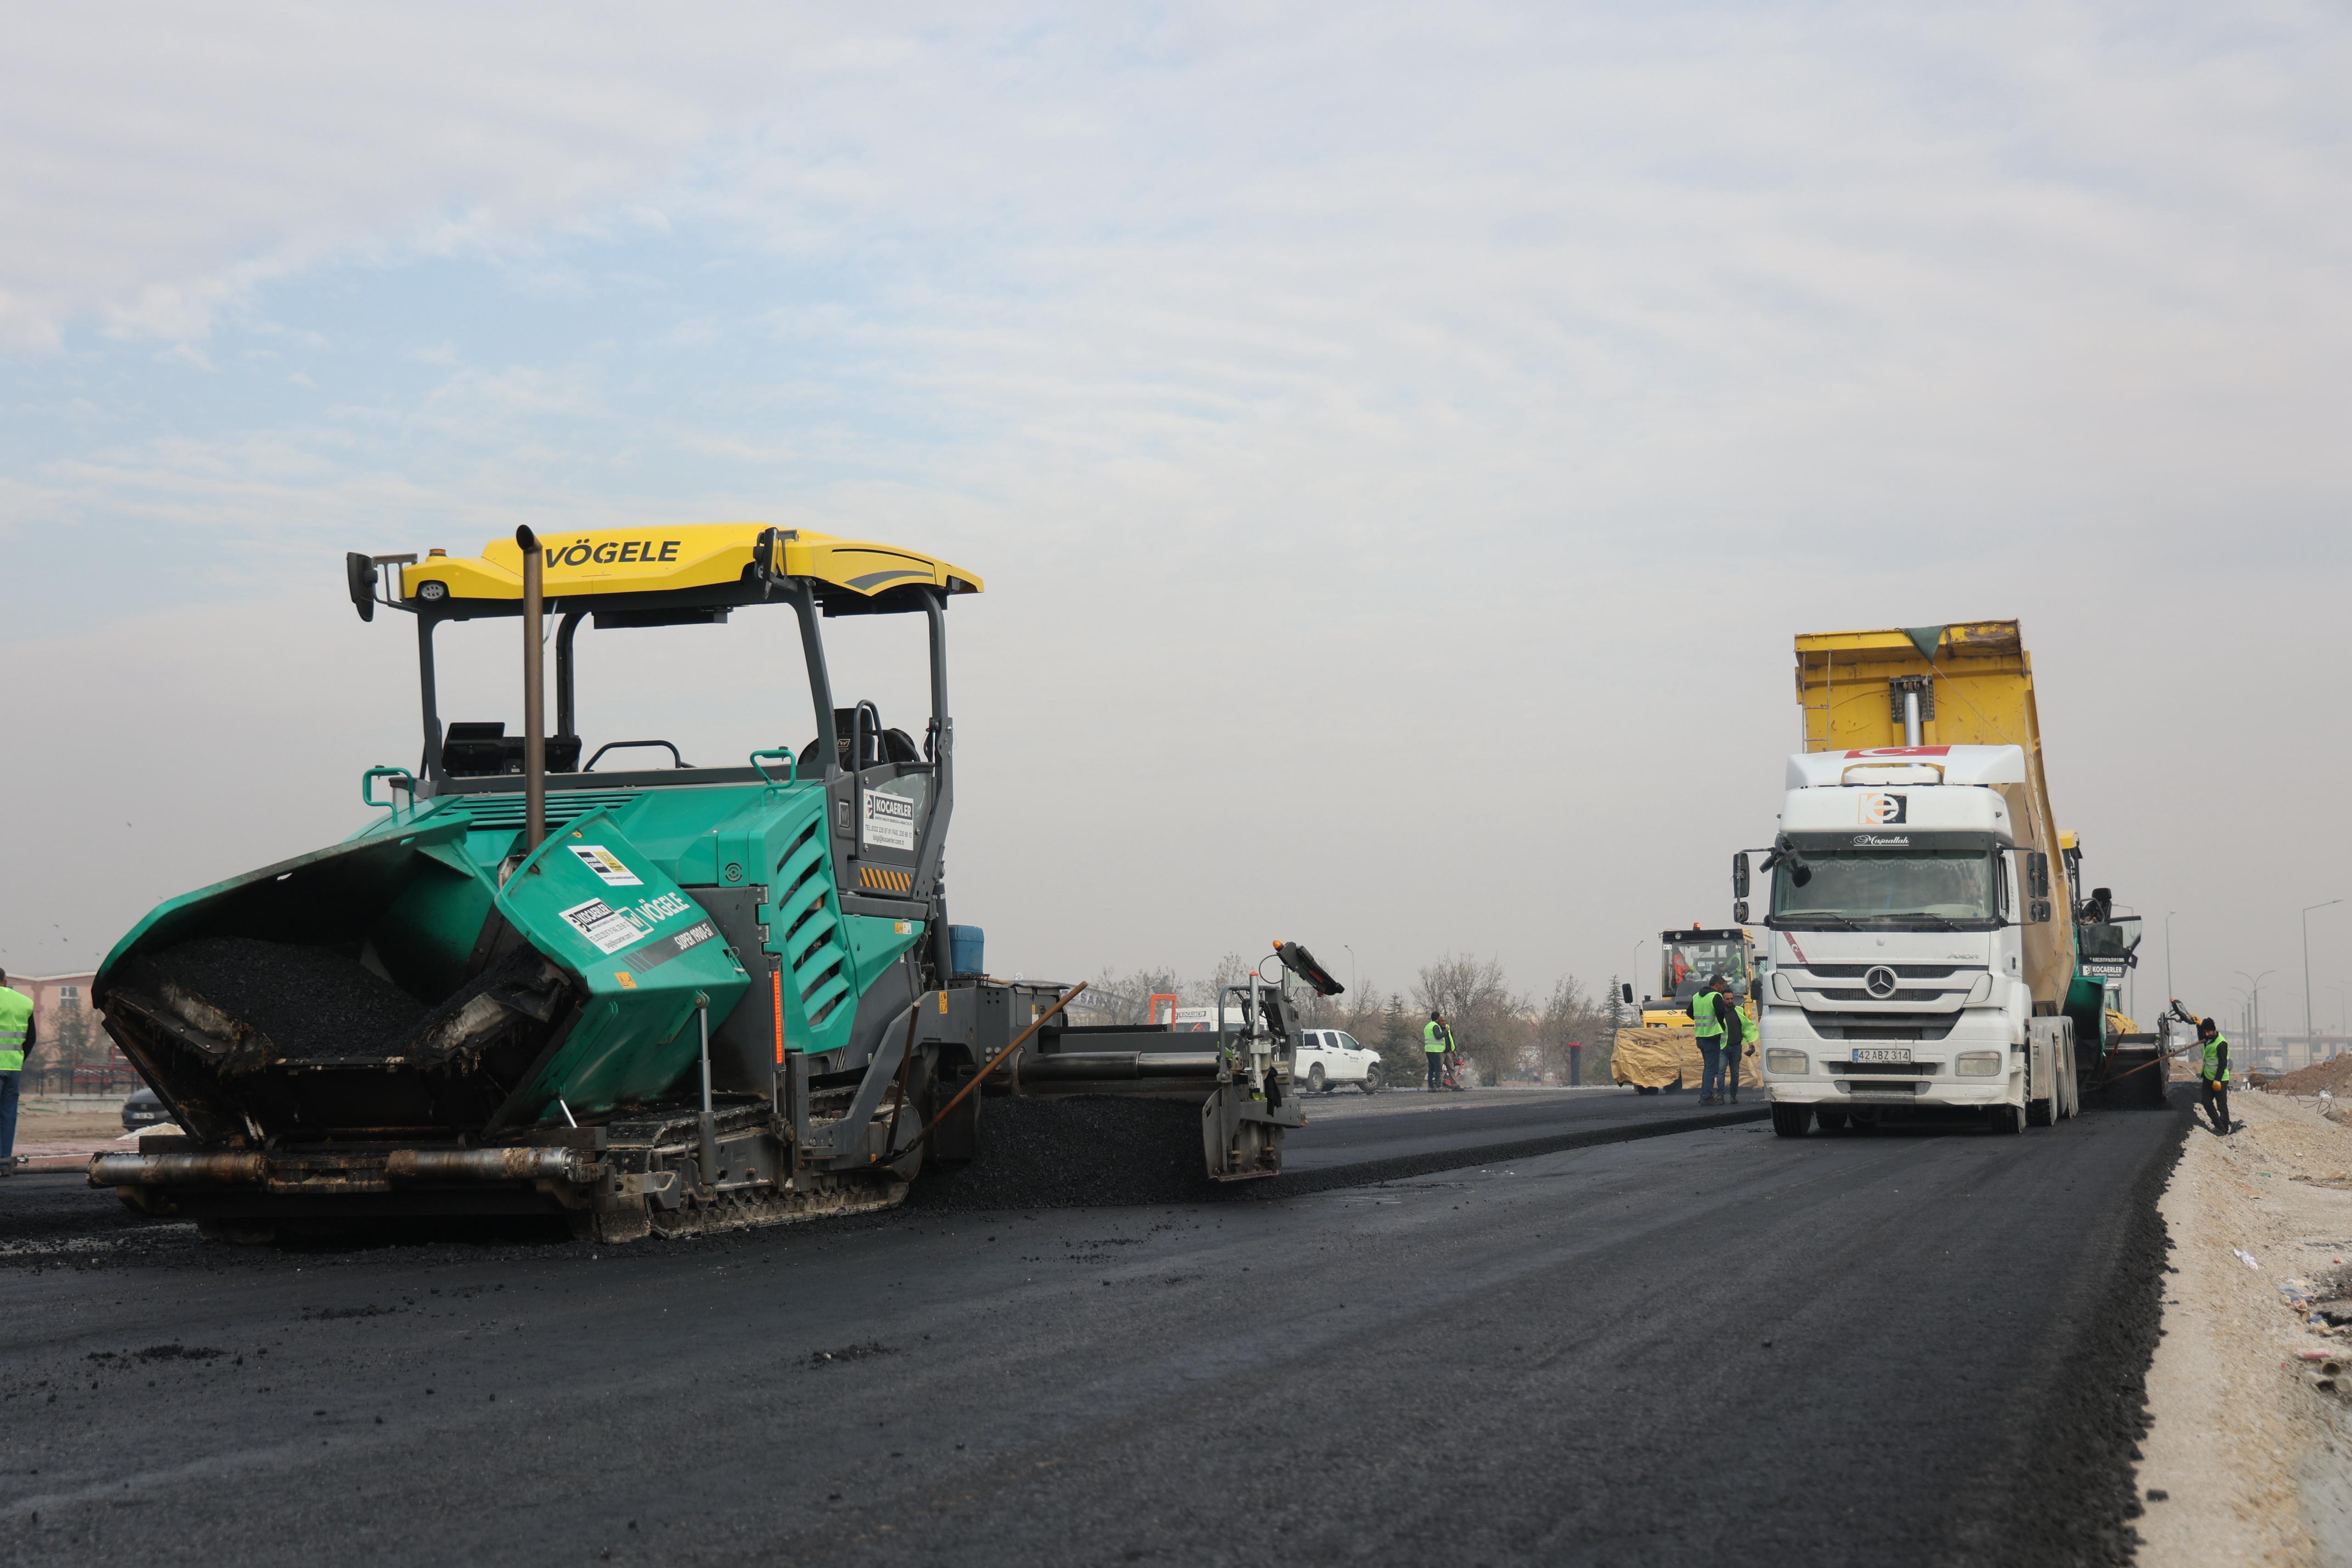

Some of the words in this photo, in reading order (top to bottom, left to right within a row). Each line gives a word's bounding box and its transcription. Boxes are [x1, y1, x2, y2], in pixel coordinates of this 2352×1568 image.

[545, 538, 681, 569] VÖGELE
[876, 799, 911, 818] KOCAERLER
[576, 904, 613, 924] KOCAERLER
[635, 892, 690, 923] VÖGELE
[674, 932, 696, 950] SUPER
[690, 922, 714, 942] 1900-5i
[1859, 1050, 1870, 1060] 42
[1872, 1050, 1889, 1060] ABZ
[1891, 1050, 1909, 1060] 314
